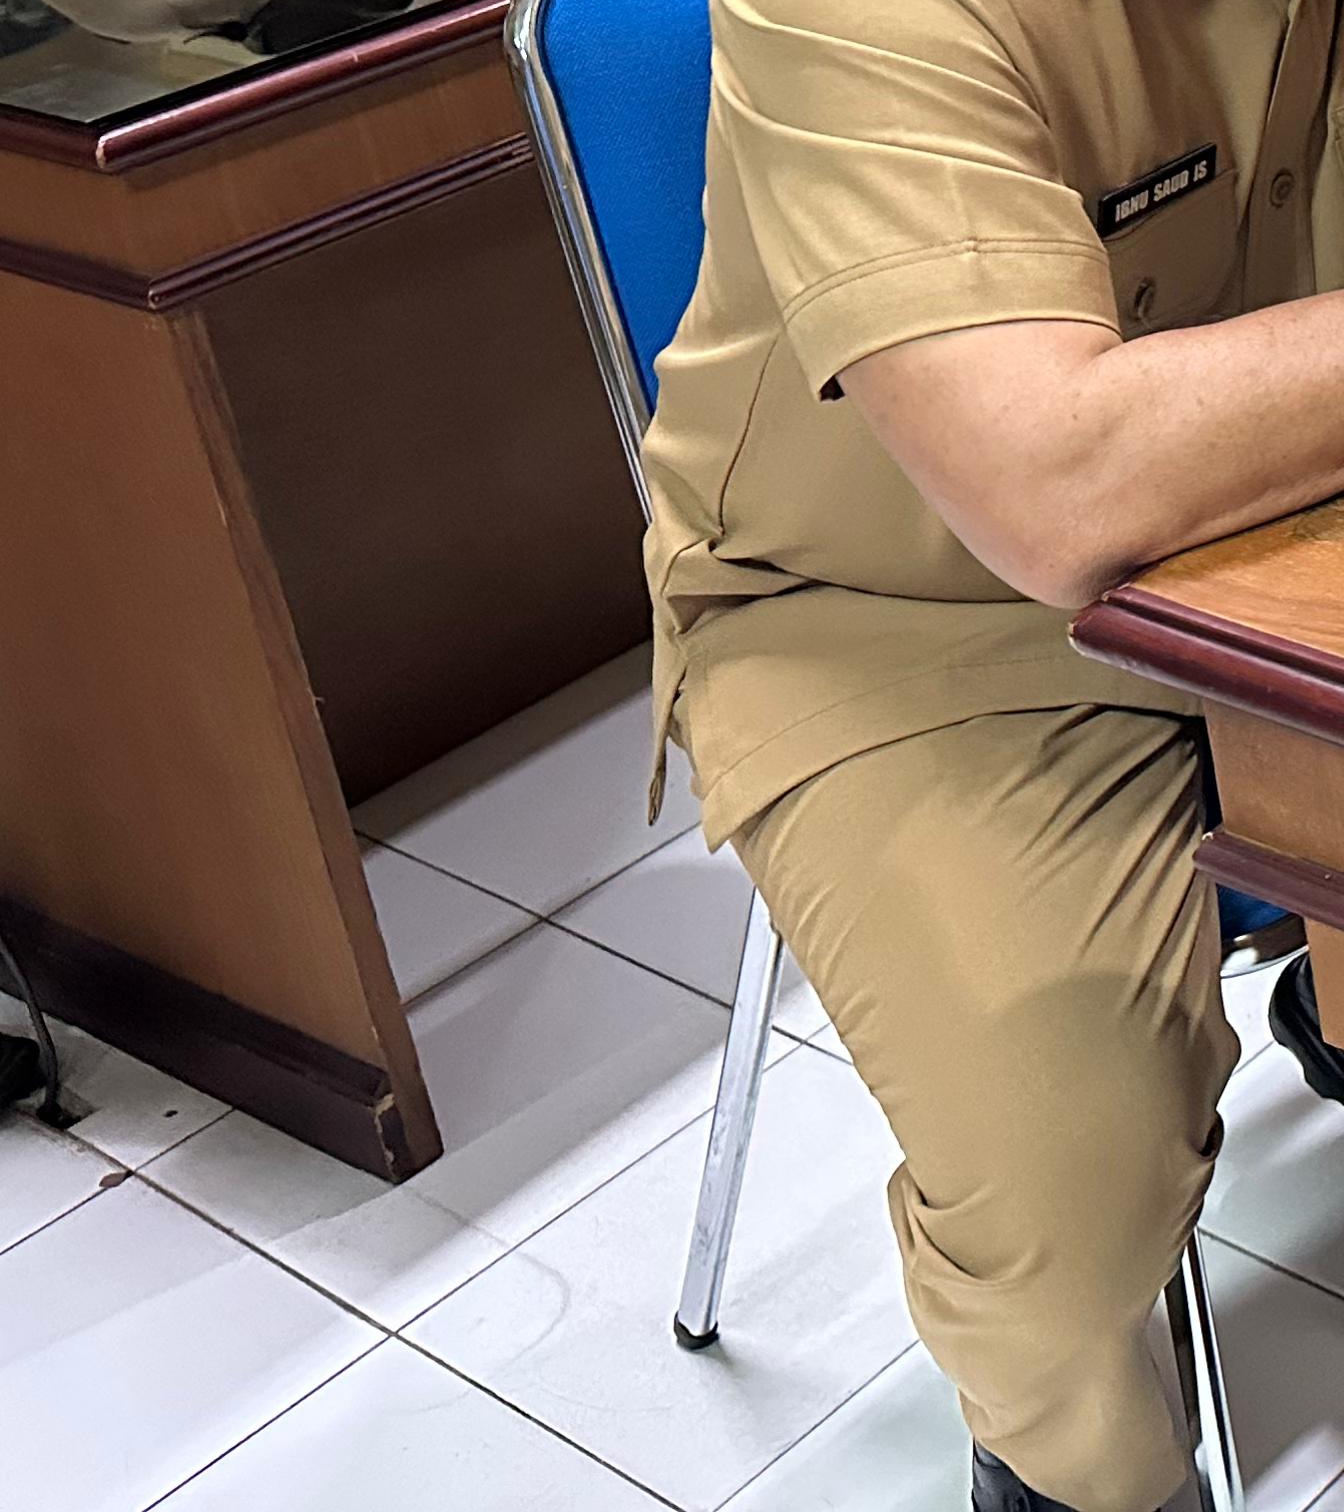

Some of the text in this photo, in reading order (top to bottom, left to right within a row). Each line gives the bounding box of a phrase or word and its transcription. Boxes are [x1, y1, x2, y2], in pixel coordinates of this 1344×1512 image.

[1115, 160, 1208, 223] IBNU SAUD IS
